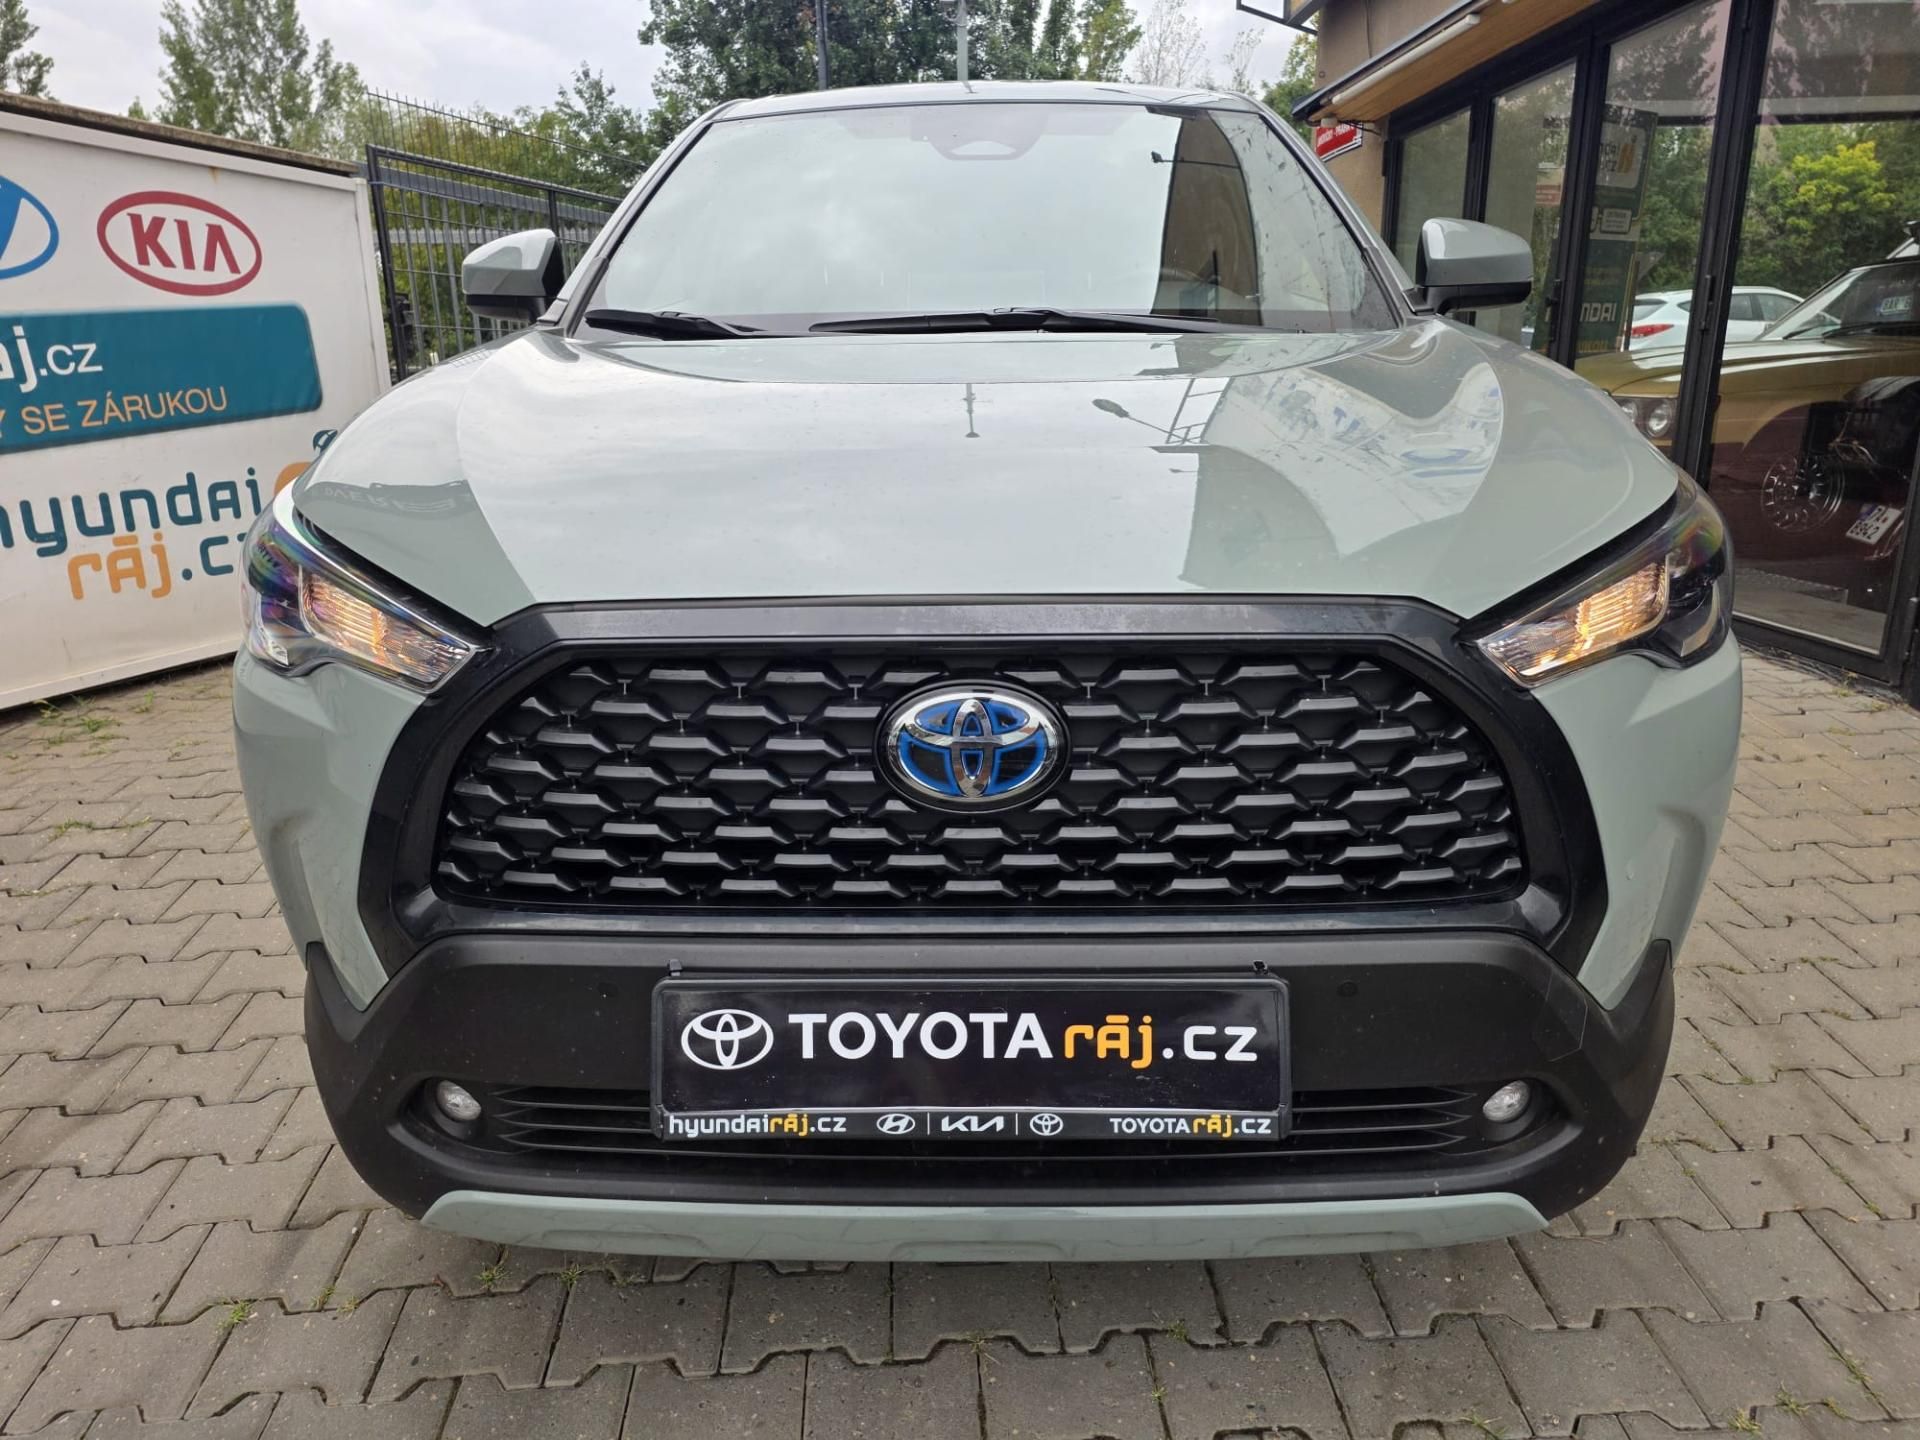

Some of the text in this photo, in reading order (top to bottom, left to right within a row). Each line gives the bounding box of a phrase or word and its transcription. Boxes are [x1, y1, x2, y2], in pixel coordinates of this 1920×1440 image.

[126, 212, 242, 275] KIA
[21, 403, 70, 434] SE
[77, 386, 228, 427] ZÁRUKOU
[66, 531, 248, 601] rāj.c
